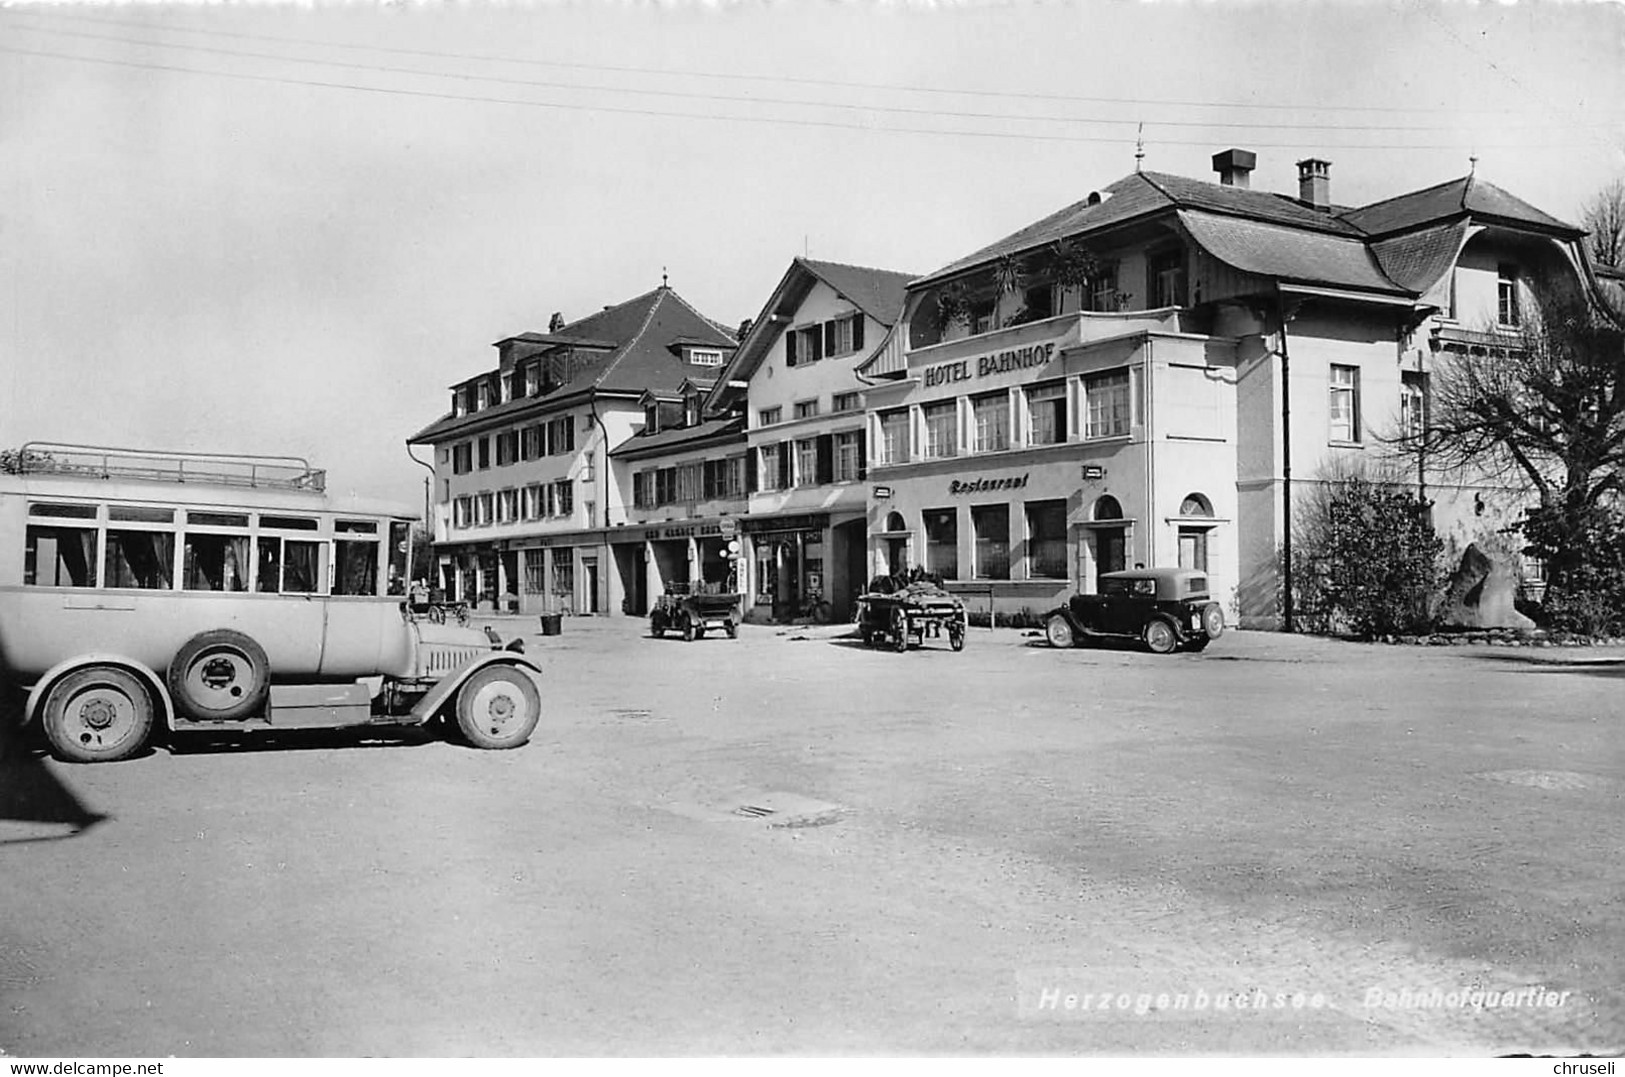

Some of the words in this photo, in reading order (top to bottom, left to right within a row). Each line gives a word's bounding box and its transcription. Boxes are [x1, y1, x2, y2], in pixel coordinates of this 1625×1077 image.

[925, 360, 972, 387] HOTEL
[978, 343, 1055, 377] BAHNHOF
[950, 472, 1029, 494] Restaurant
